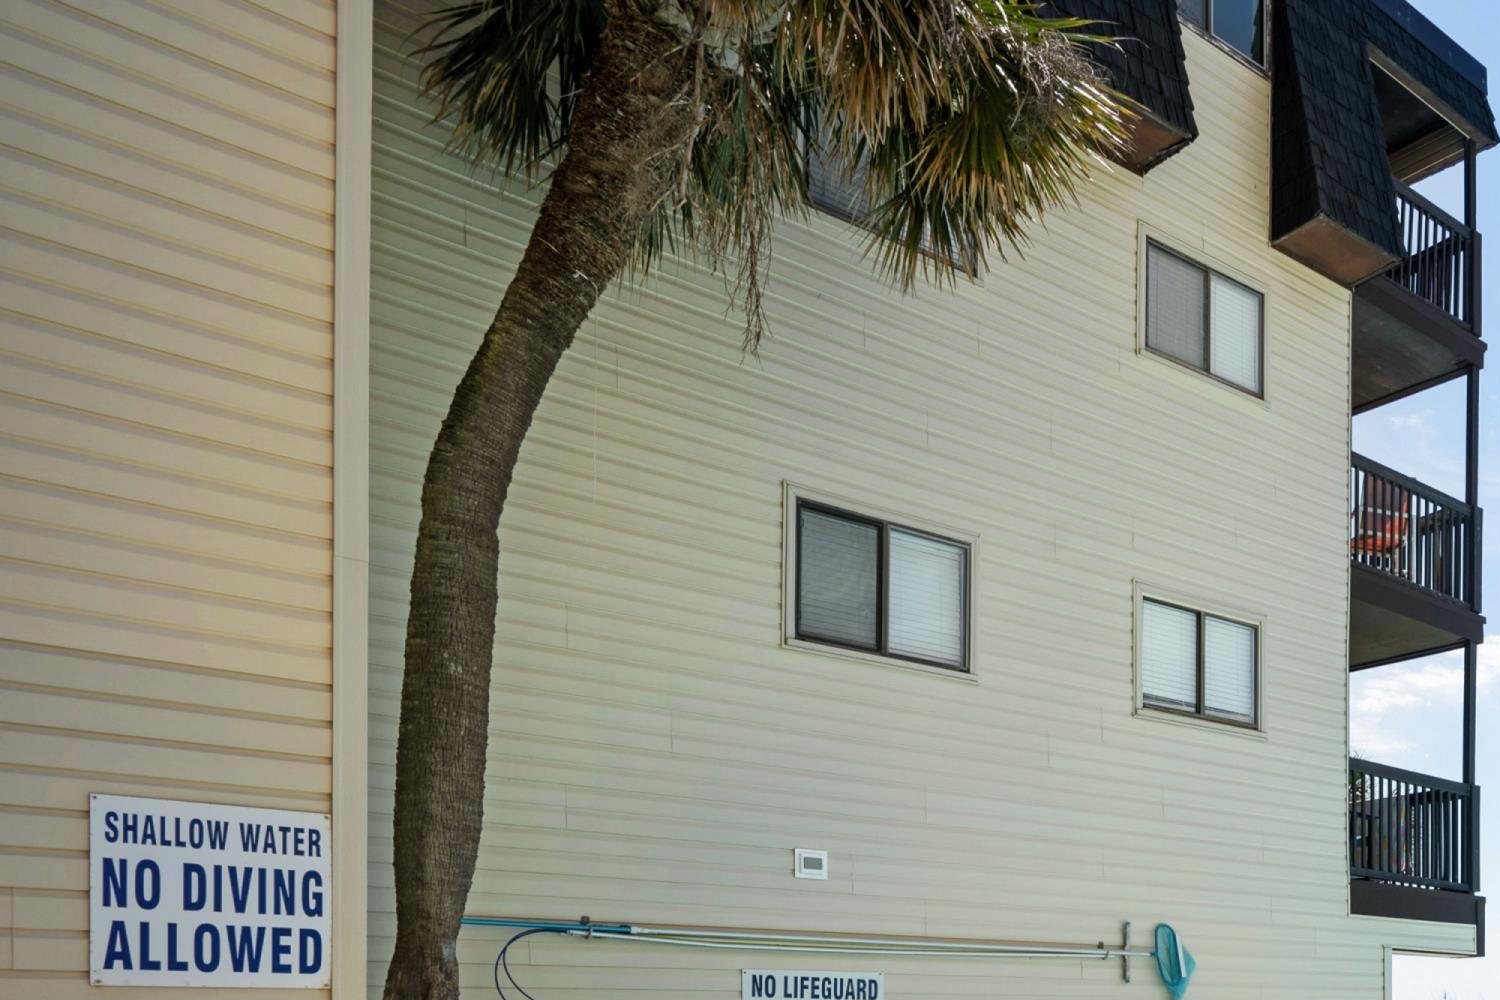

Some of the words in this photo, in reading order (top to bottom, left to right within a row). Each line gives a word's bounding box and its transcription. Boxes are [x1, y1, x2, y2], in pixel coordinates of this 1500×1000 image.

[104, 810, 229, 851] SHALLOW
[239, 822, 322, 858] WATER
[102, 857, 161, 910] NO
[182, 862, 324, 918] DIVING
[103, 920, 323, 975] ALLOWED
[751, 974, 777, 998] NO
[783, 975, 879, 1000] LIFEGUARD
